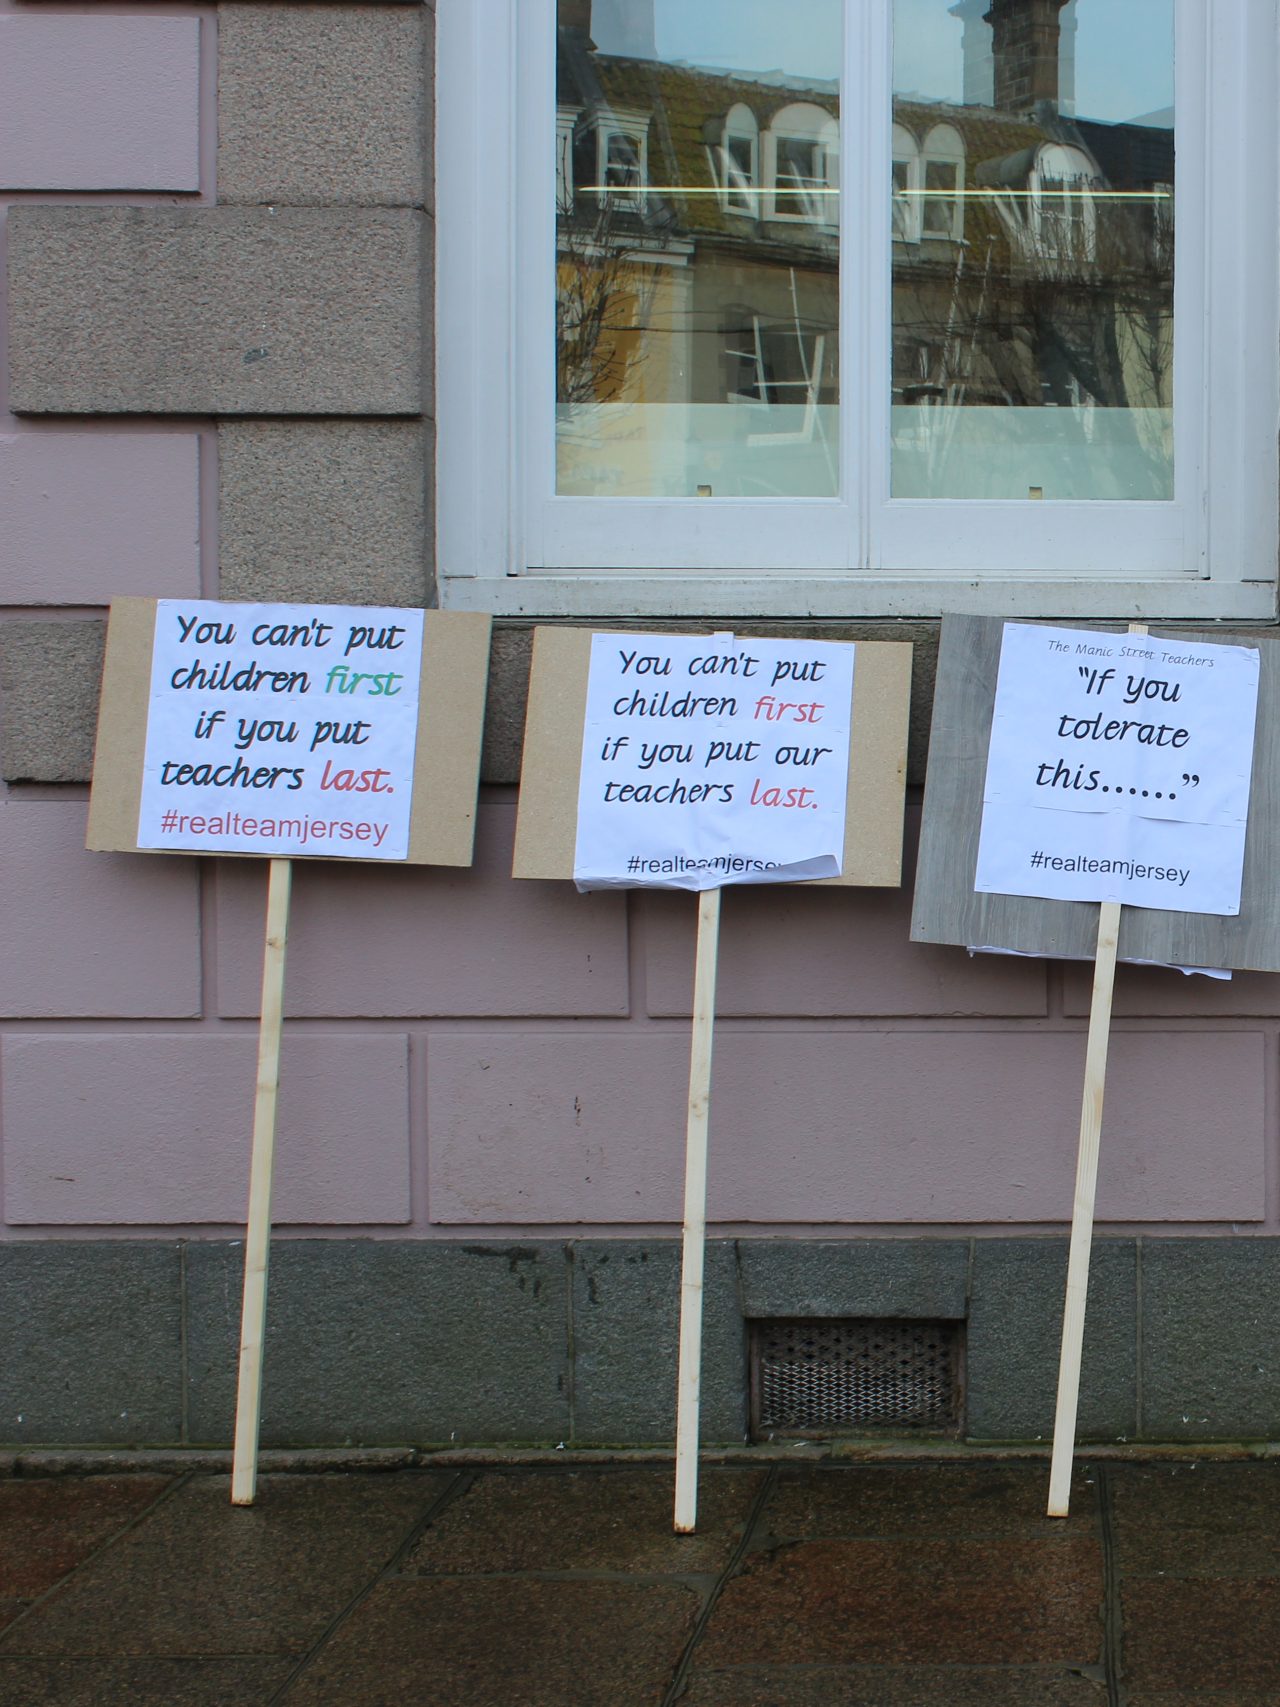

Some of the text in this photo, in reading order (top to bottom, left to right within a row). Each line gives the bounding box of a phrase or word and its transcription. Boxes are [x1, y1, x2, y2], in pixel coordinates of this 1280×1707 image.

[177, 615, 406, 656] You can't put
[619, 650, 827, 687] You can't put
[1048, 640, 1215, 668] The Manic Street Teachers
[171, 659, 404, 696] children first
[1123, 675, 1182, 704] you
[613, 689, 825, 723] children first
[194, 710, 372, 752] if you put
[1057, 712, 1191, 748] tolerate
[601, 736, 833, 769] if you put our
[161, 757, 394, 794] teachers last.
[604, 778, 819, 809] teachers last.
[161, 809, 390, 847] #realteamjersey
[627, 854, 782, 873] #realteamjerse
[1030, 850, 1191, 887] #realteamjersey
